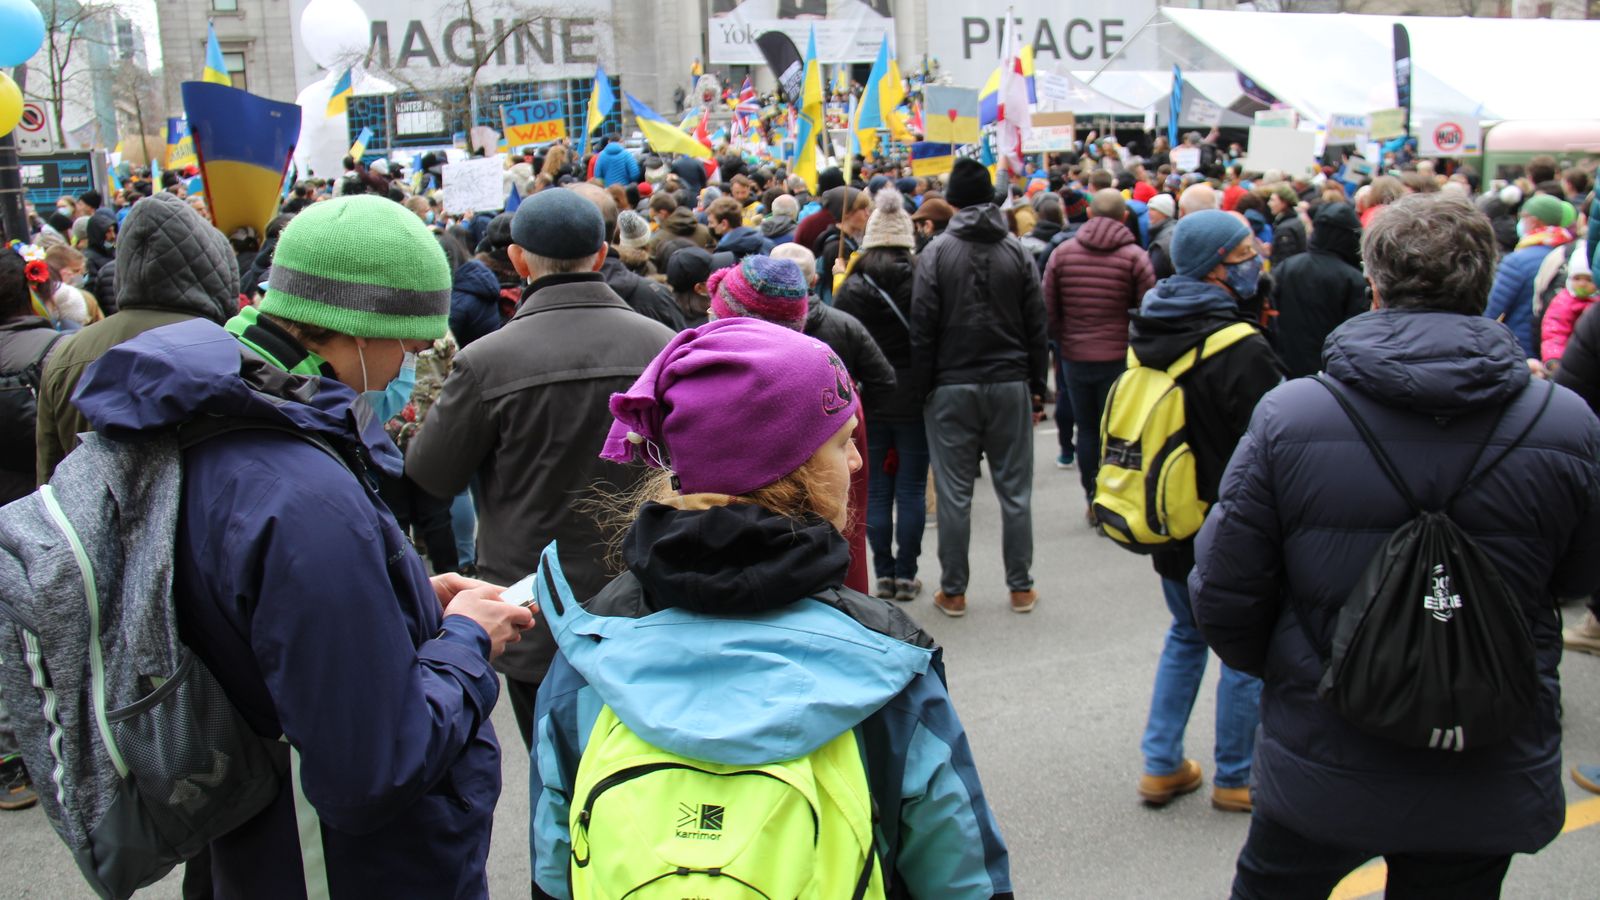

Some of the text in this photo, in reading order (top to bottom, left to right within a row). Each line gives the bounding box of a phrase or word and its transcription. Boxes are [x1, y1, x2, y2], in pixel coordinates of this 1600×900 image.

[363, 17, 597, 69] MAGINE
[720, 23, 758, 45] Yok
[506, 102, 558, 126] STOP
[512, 122, 558, 142] WAR
[675, 829, 722, 840] karrimor
